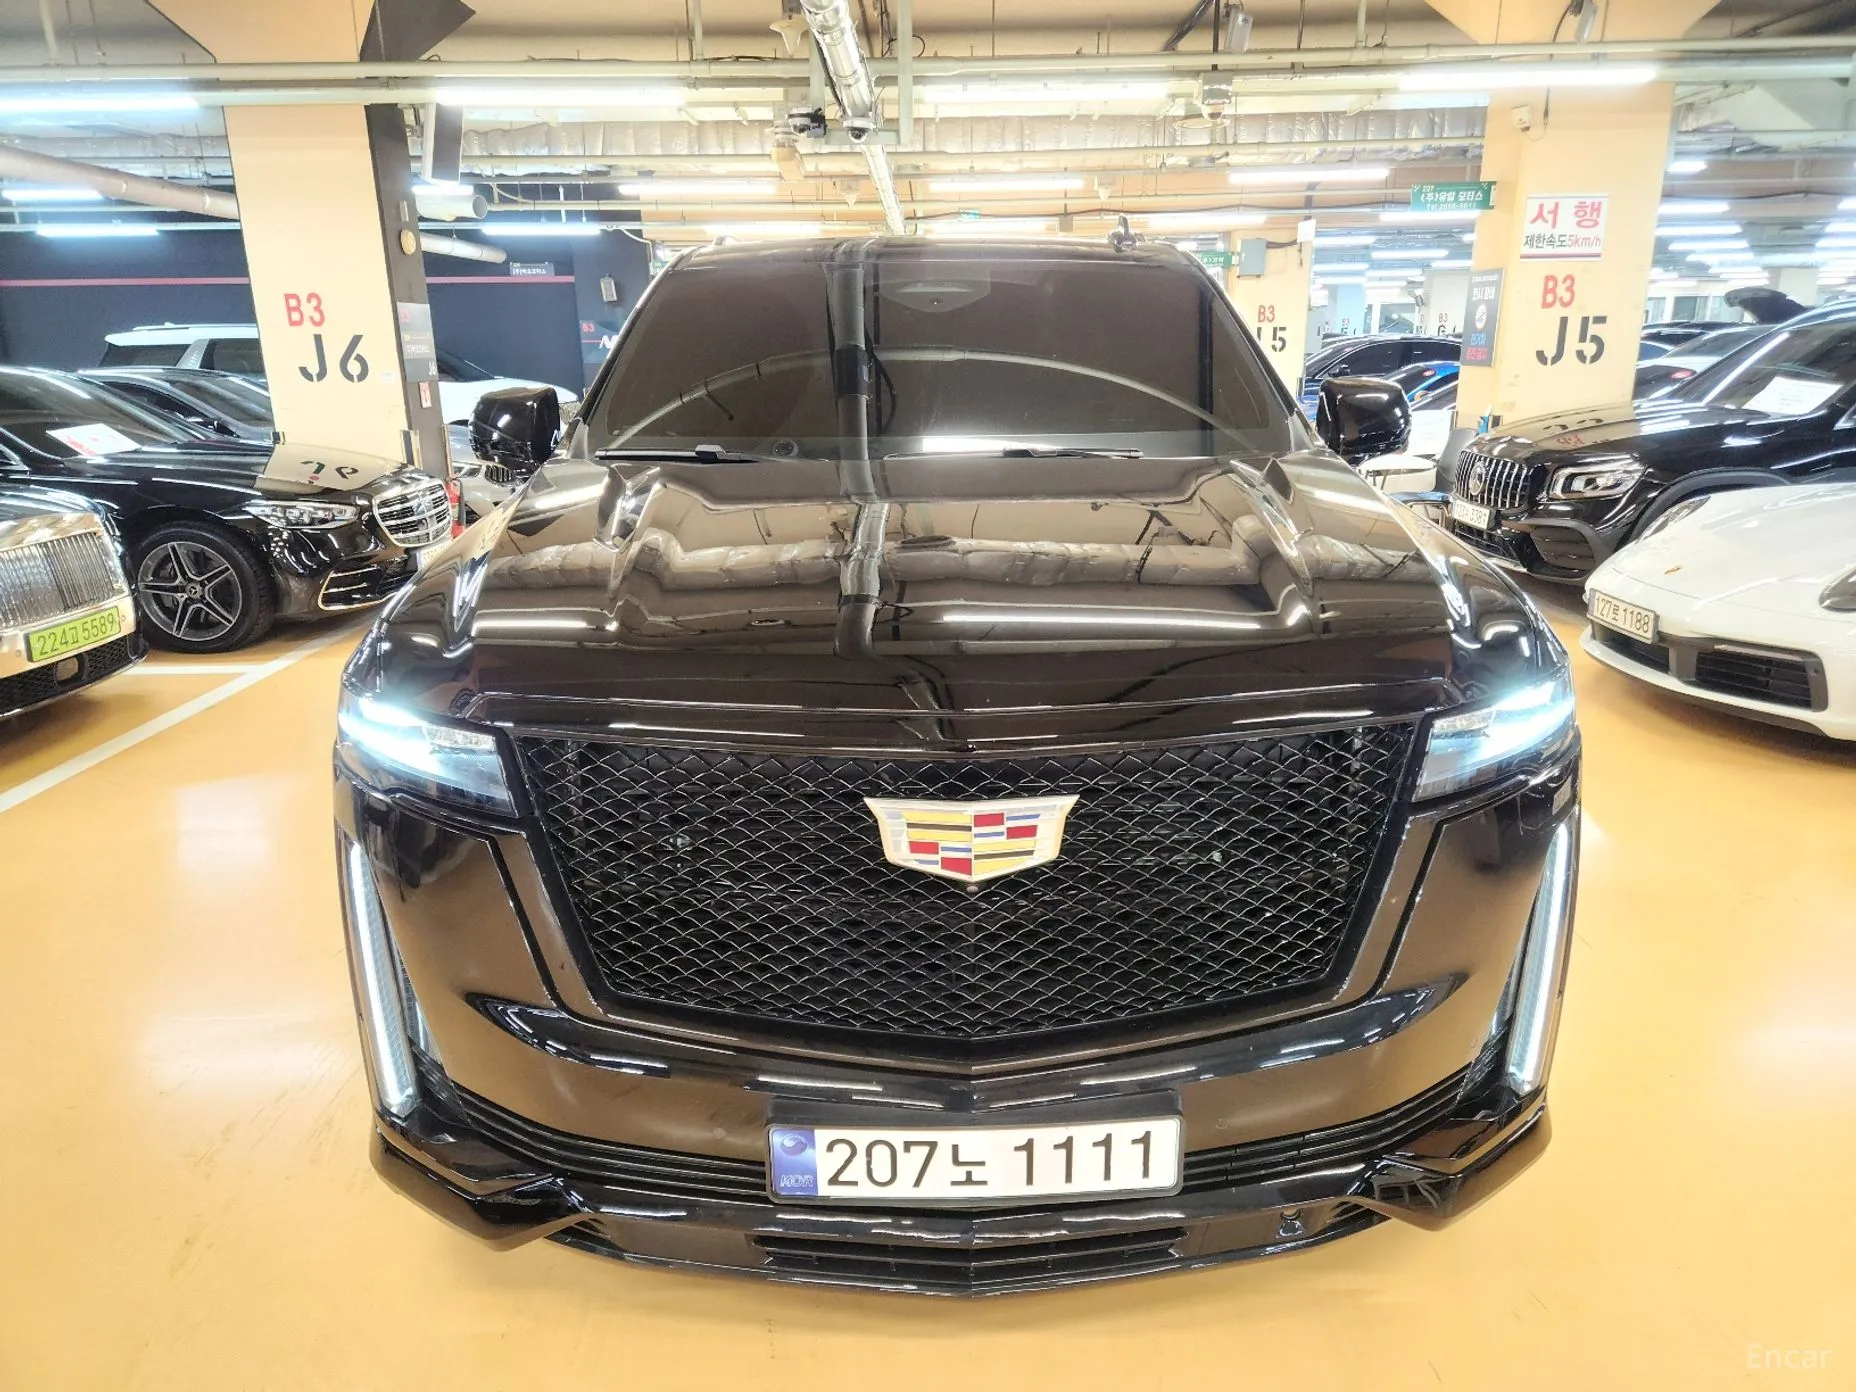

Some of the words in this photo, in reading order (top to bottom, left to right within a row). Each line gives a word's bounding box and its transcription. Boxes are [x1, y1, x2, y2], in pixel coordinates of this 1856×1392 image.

[284, 292, 325, 327] B3
[1541, 273, 1576, 310] B3
[1257, 304, 1276, 323] B3
[298, 333, 369, 383] J6
[1535, 315, 1608, 367] J5
[81, 612, 115, 641] 5589
[1596, 596, 1620, 622] 127로
[1622, 607, 1650, 633] 1188
[825, 1138, 988, 1188] 207노
[1013, 1130, 1151, 1186] 1111
[779, 1174, 814, 1187] KOR
